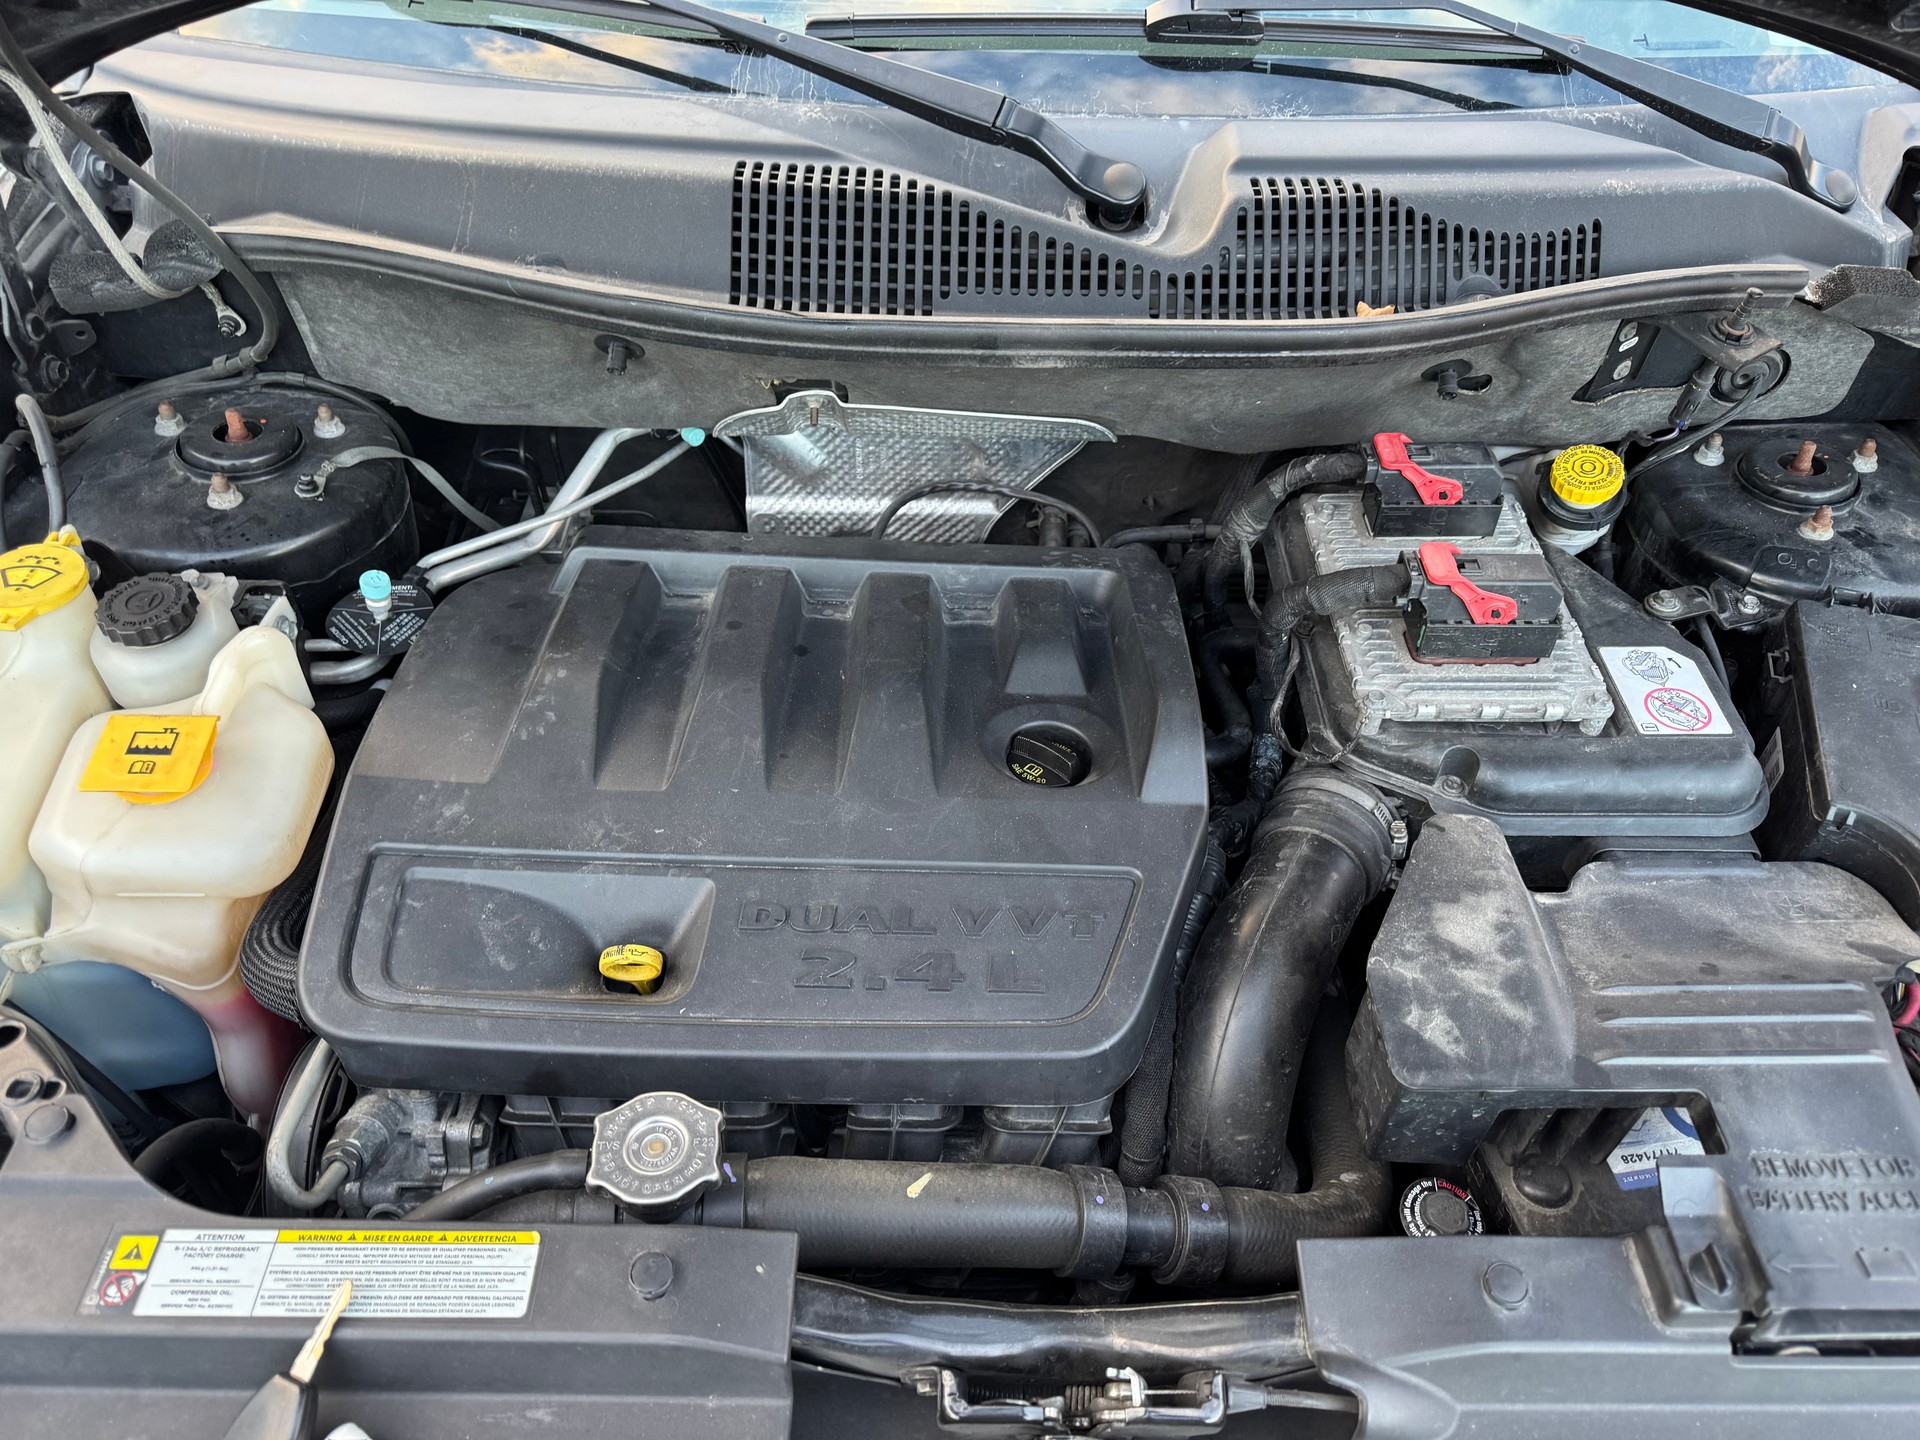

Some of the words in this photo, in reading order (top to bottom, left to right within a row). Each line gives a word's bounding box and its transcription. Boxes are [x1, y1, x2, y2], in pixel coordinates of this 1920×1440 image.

[1011, 762, 1024, 775] SAE
[1021, 772, 1047, 785] 5W-20
[738, 902, 938, 936] DUAL
[951, 903, 1107, 941] VVT
[602, 946, 626, 960] ENGINE
[793, 949, 965, 993] 2.4
[987, 952, 1047, 995] L
[664, 1127, 677, 1141] LBS
[597, 1140, 621, 1151] TVS
[1751, 1156, 1853, 1178] REMOVE
[1860, 1156, 1916, 1178] FOR
[642, 1174, 685, 1195] OPEN
[1420, 1180, 1432, 1188] the
[1437, 1180, 1467, 1200] CAUTION
[1403, 1184, 1422, 1208] damage
[1746, 1188, 1850, 1212] BATTERY
[1403, 1208, 1412, 1222] will
[196, 1233, 246, 1241] ATTENTION
[297, 1234, 342, 1242] WARNING
[362, 1235, 385, 1243] MISE
[387, 1235, 400, 1243] EN
[402, 1235, 433, 1243] GARDE
[453, 1235, 516, 1243] ADVERTENCIA
